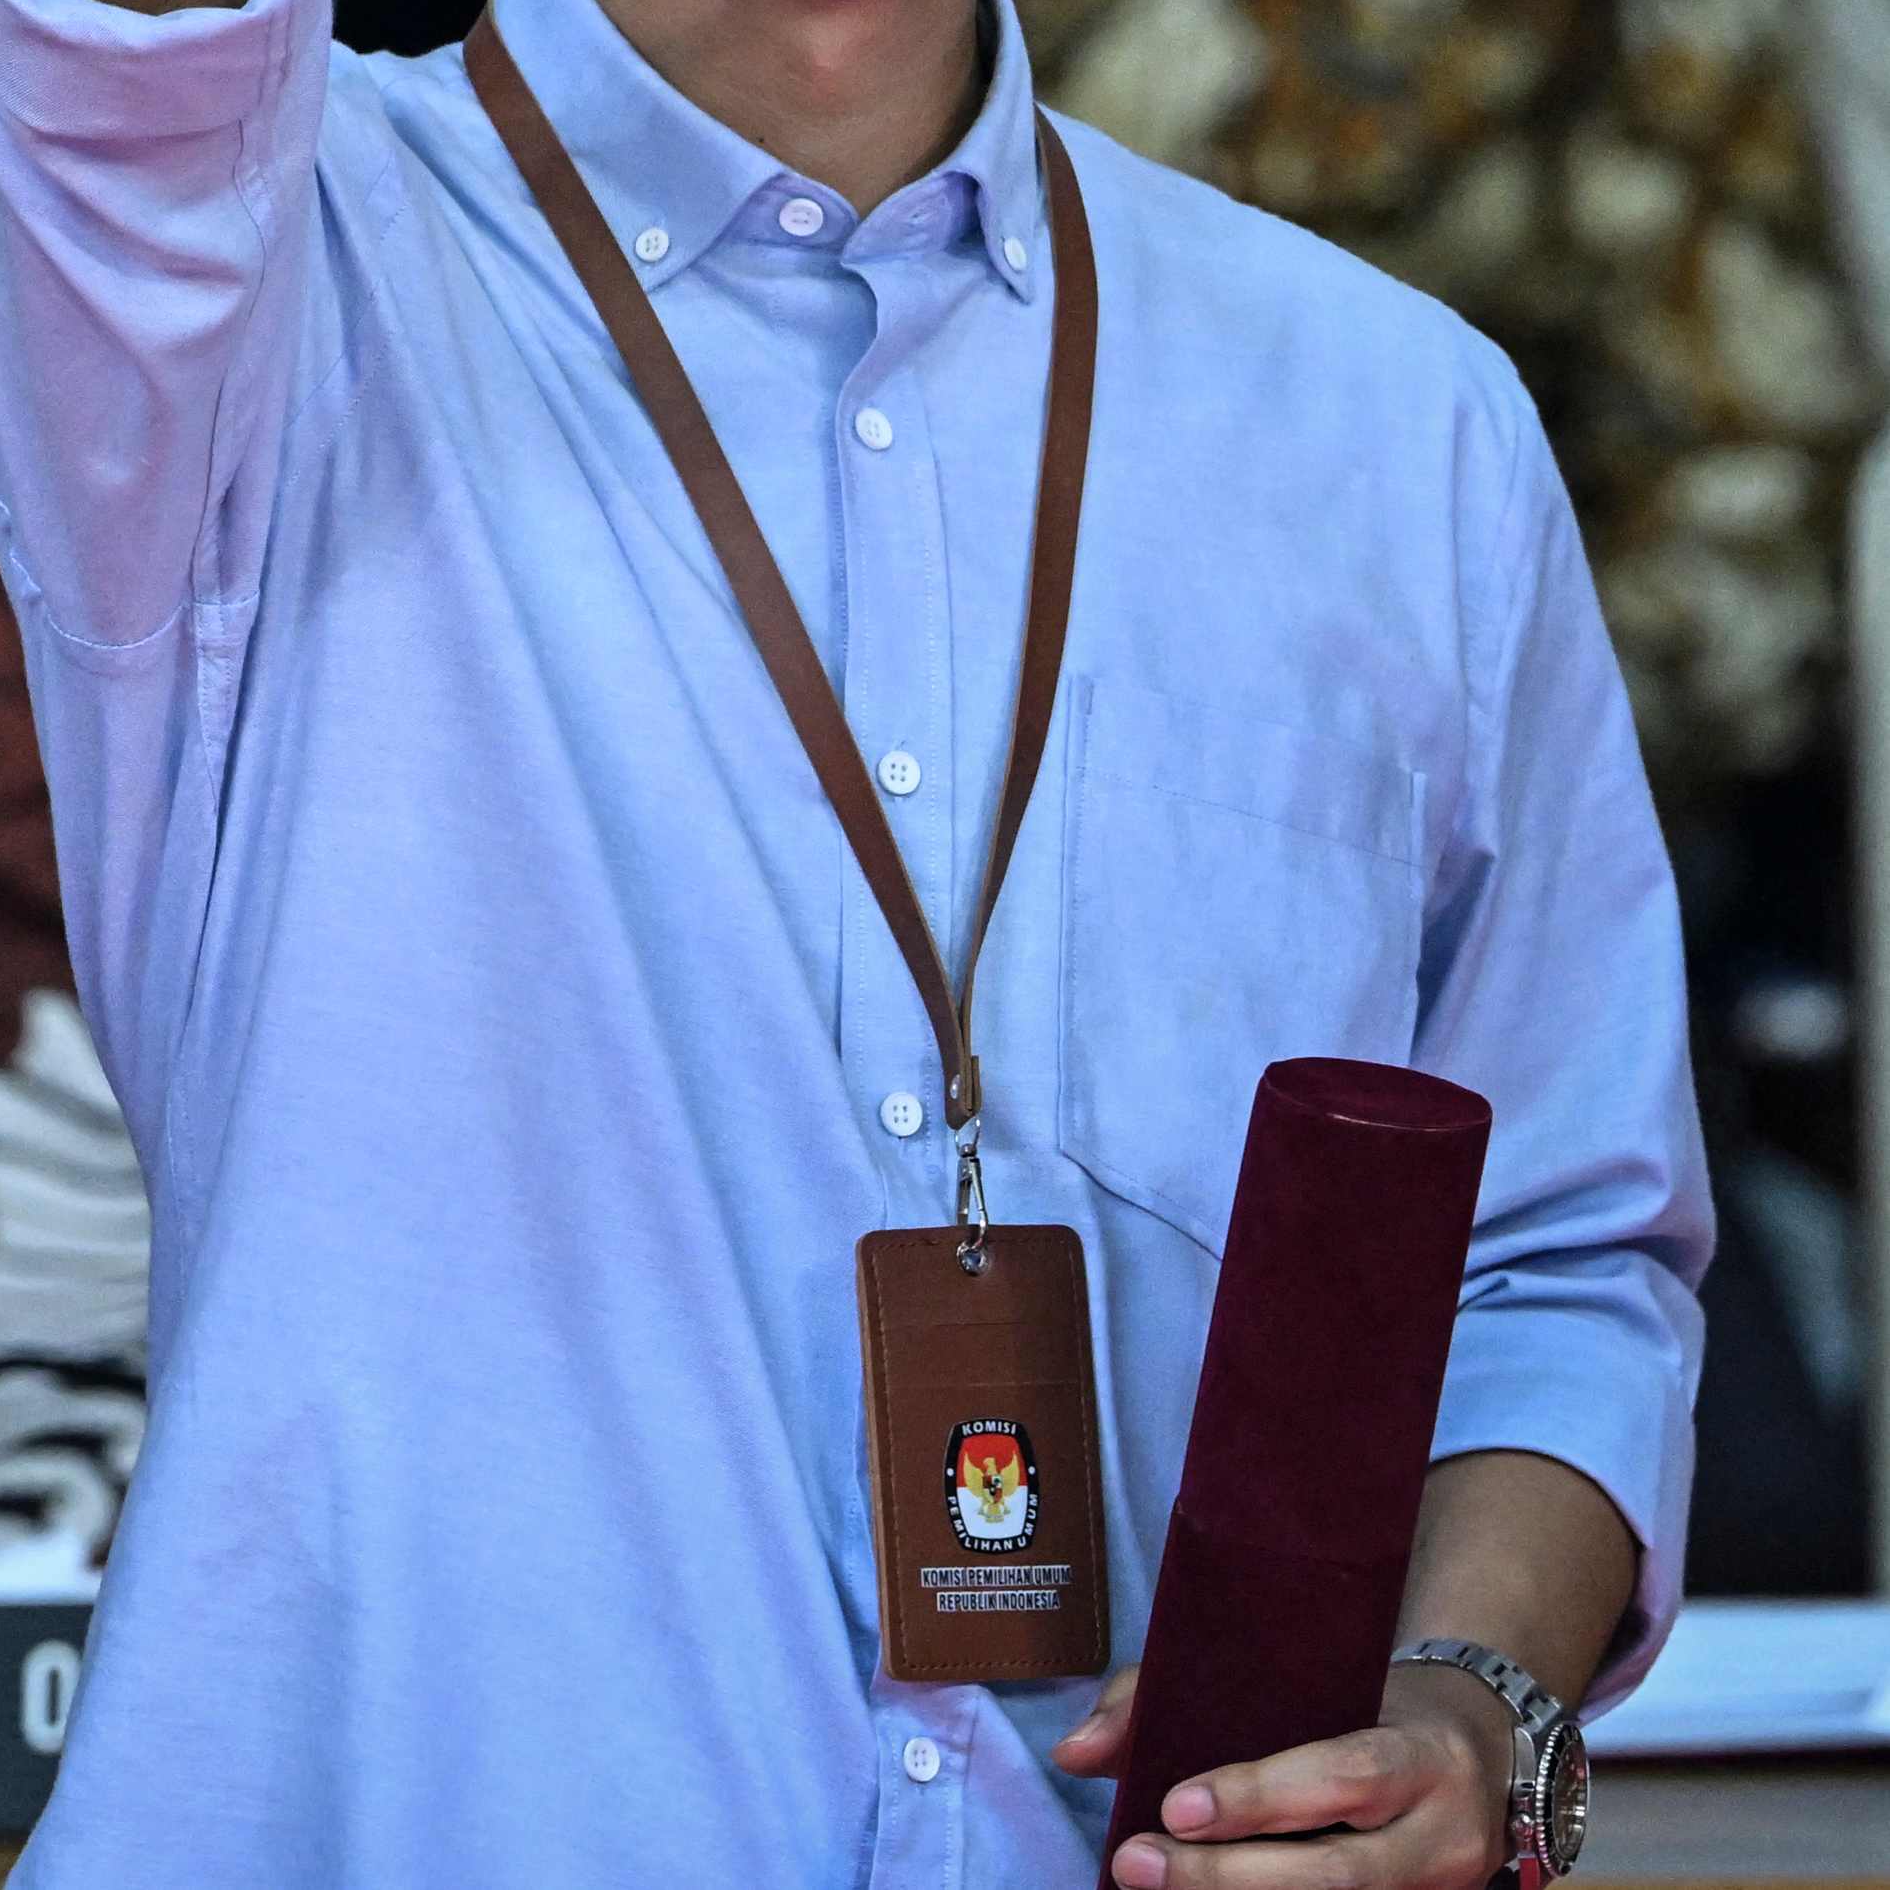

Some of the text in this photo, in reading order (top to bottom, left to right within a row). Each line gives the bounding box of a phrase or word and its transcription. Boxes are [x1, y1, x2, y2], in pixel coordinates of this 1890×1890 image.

[961, 1420, 1017, 1436] KOMISI
[947, 1493, 1038, 1552] PEMILIHAN UMUM
[922, 1565, 1072, 1587] KOMISI PEMILIHAN UMUM
[938, 1590, 1060, 1611] REPUBLIK INDONESIA
